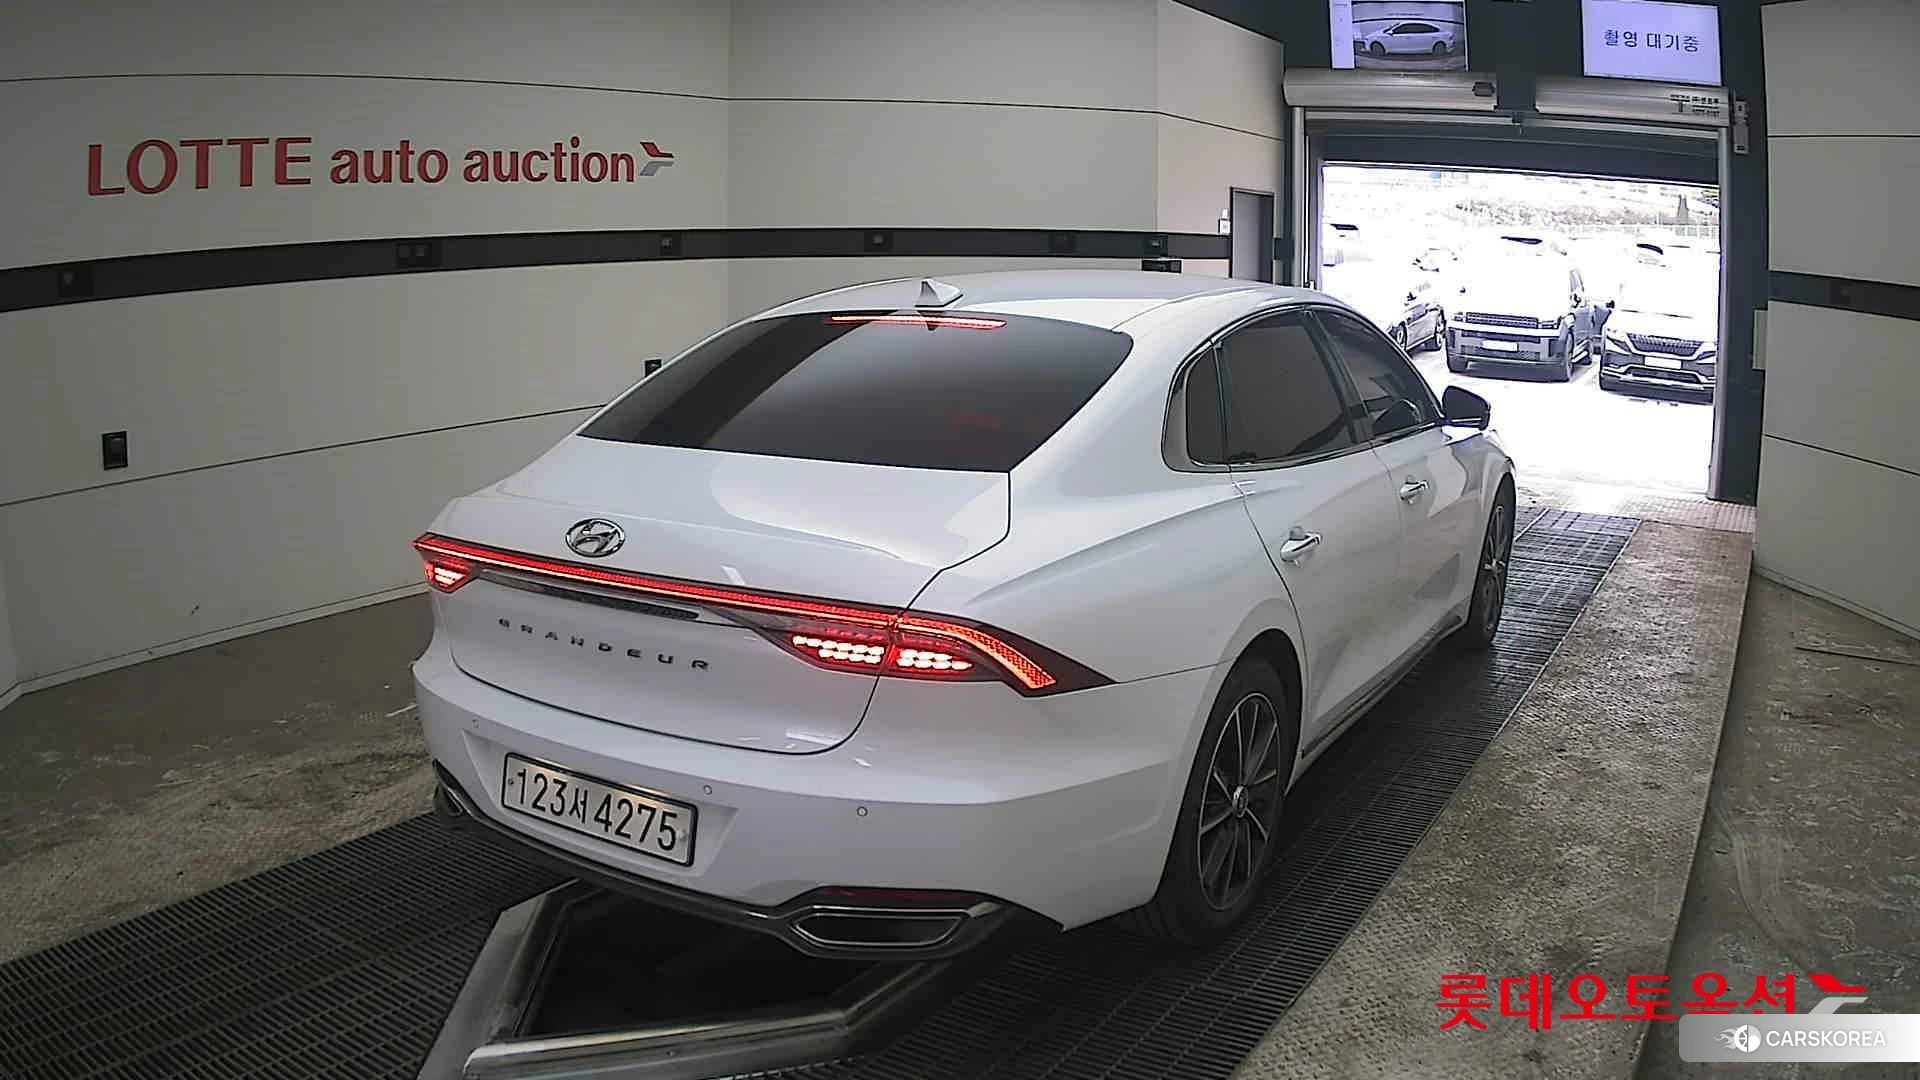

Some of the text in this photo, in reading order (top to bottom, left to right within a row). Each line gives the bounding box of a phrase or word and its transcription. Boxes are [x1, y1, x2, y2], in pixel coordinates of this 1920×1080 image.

[1604, 29, 1699, 53] 촬영 대기중
[87, 136, 636, 196] LOTTE auto auction
[498, 618, 709, 670] GRANDEUR
